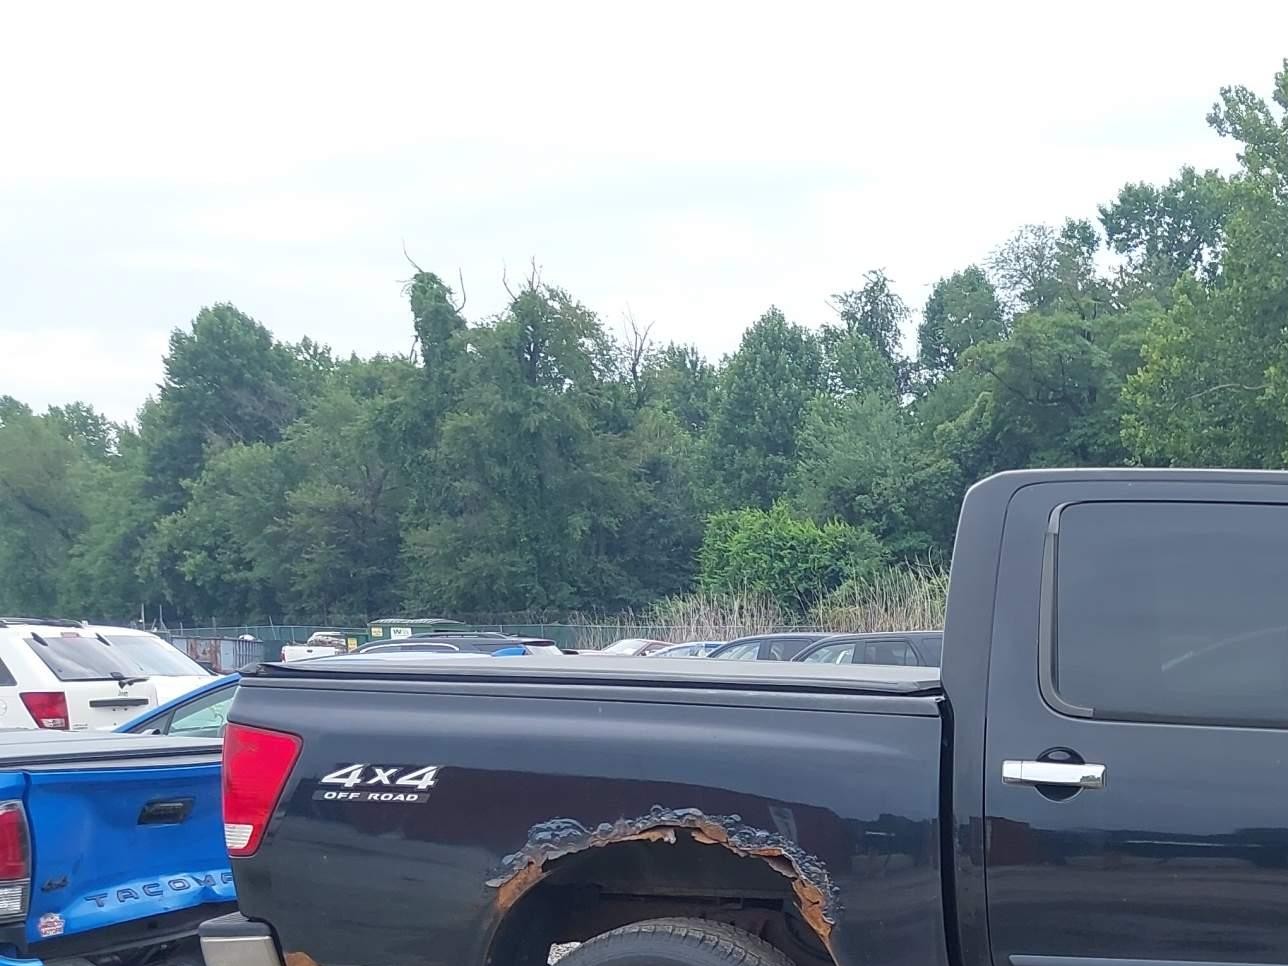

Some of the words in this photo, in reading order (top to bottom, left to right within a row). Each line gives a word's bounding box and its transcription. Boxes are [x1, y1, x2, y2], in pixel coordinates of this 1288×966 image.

[320, 763, 438, 790] 4x4
[324, 791, 361, 800] OFF
[367, 792, 419, 802] ROAD
